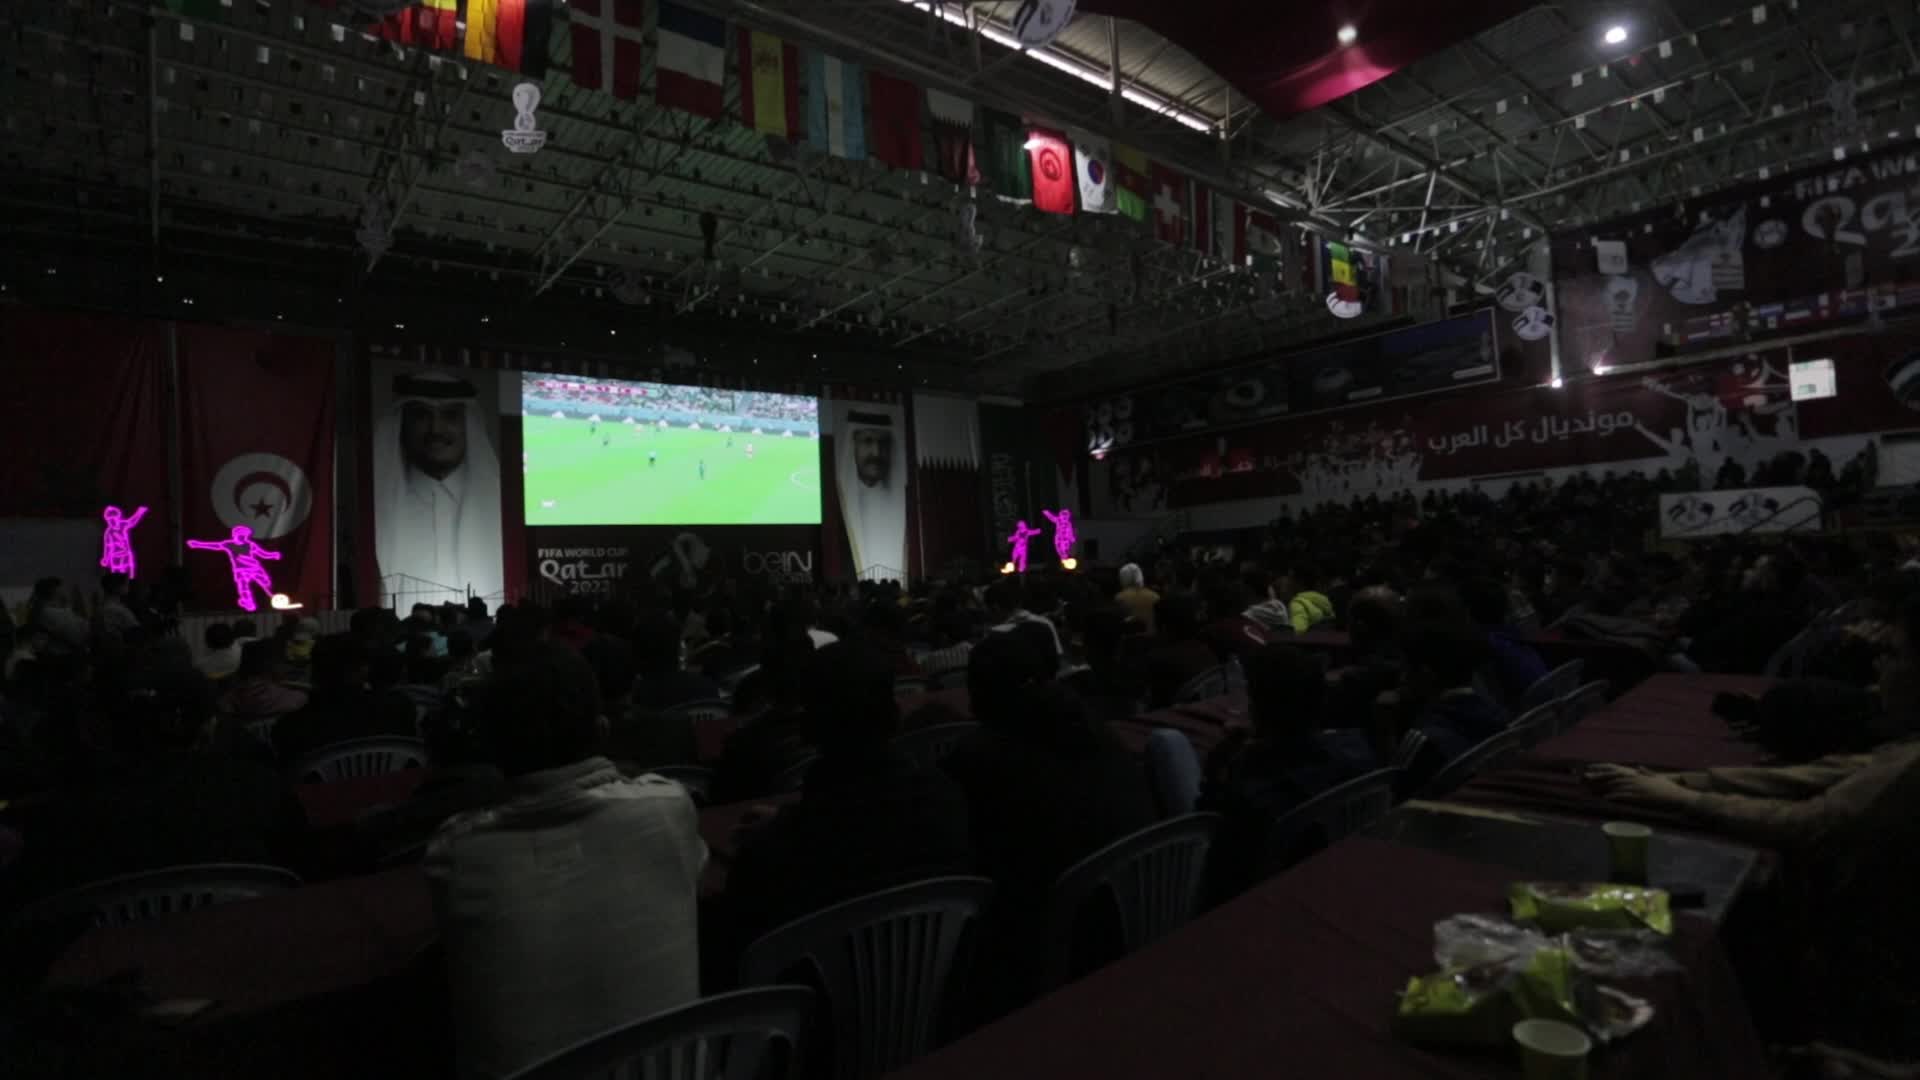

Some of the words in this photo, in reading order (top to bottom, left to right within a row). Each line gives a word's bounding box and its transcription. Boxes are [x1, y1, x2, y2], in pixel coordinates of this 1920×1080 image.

[1427, 424, 1489, 455] العرب
[1494, 419, 1525, 448] كل
[1530, 409, 1634, 444] مونديال
[537, 547, 563, 559] FIFA
[564, 547, 606, 558] WORLD
